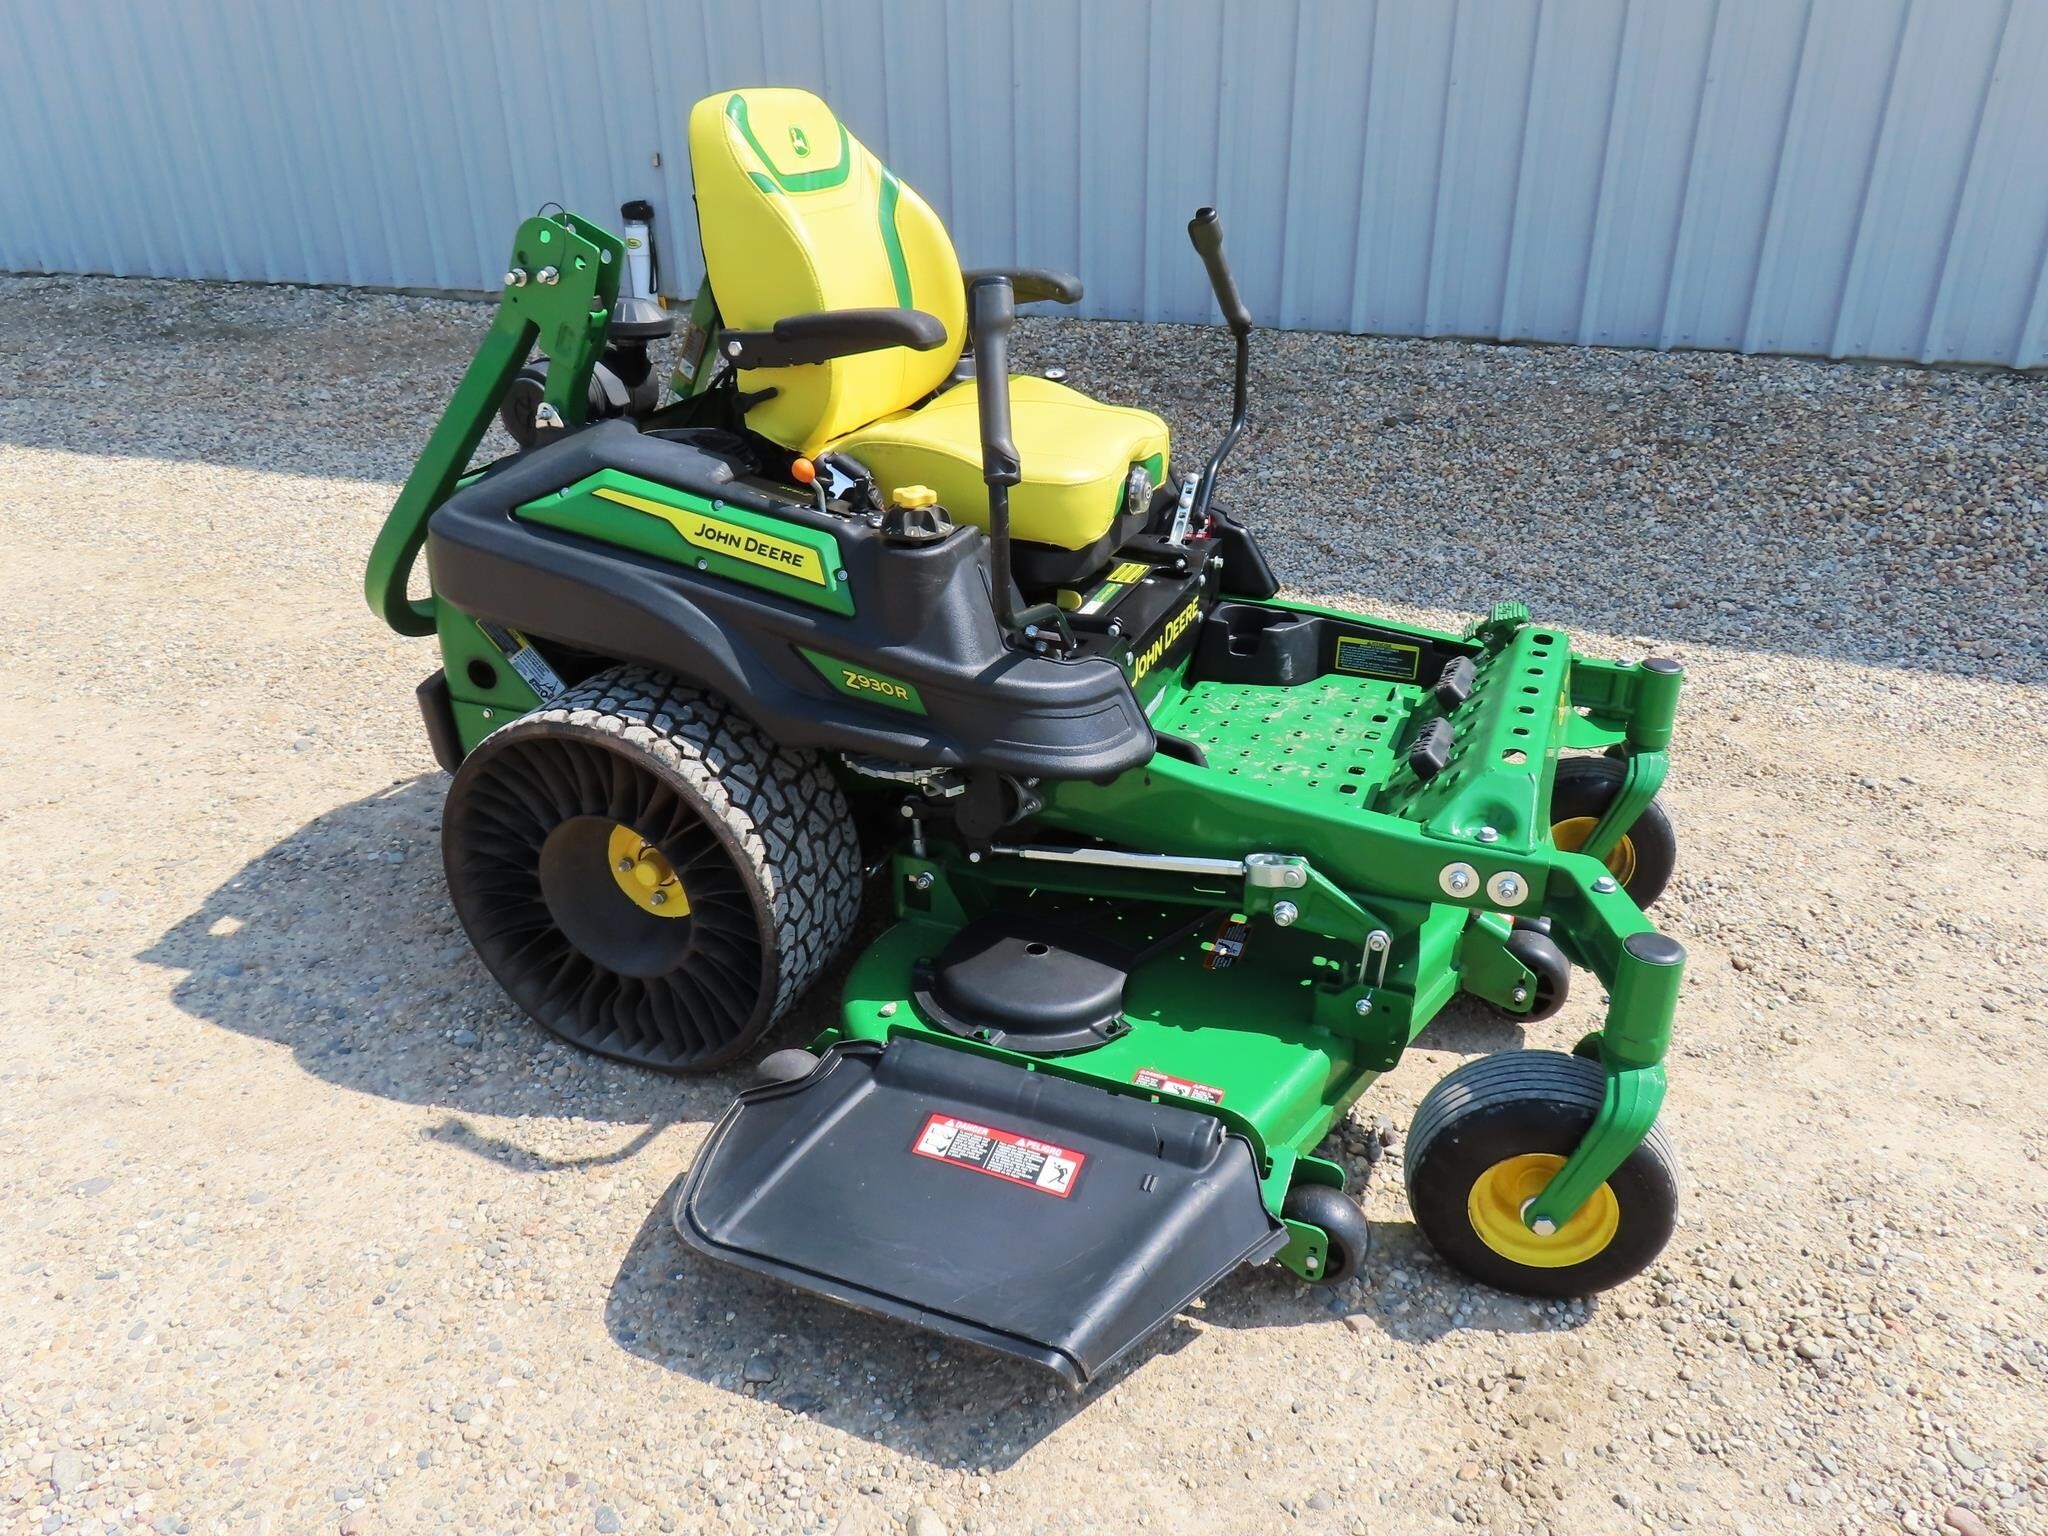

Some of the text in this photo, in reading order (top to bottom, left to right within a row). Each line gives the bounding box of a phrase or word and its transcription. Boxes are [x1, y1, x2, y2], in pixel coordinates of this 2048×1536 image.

[694, 523, 805, 568] JOHN DEERE
[1131, 595, 1200, 688] JOHN DEERE
[842, 670, 909, 700] Z930R
[955, 1121, 989, 1136] DANGER
[1025, 1140, 1063, 1157] PELIGRO
